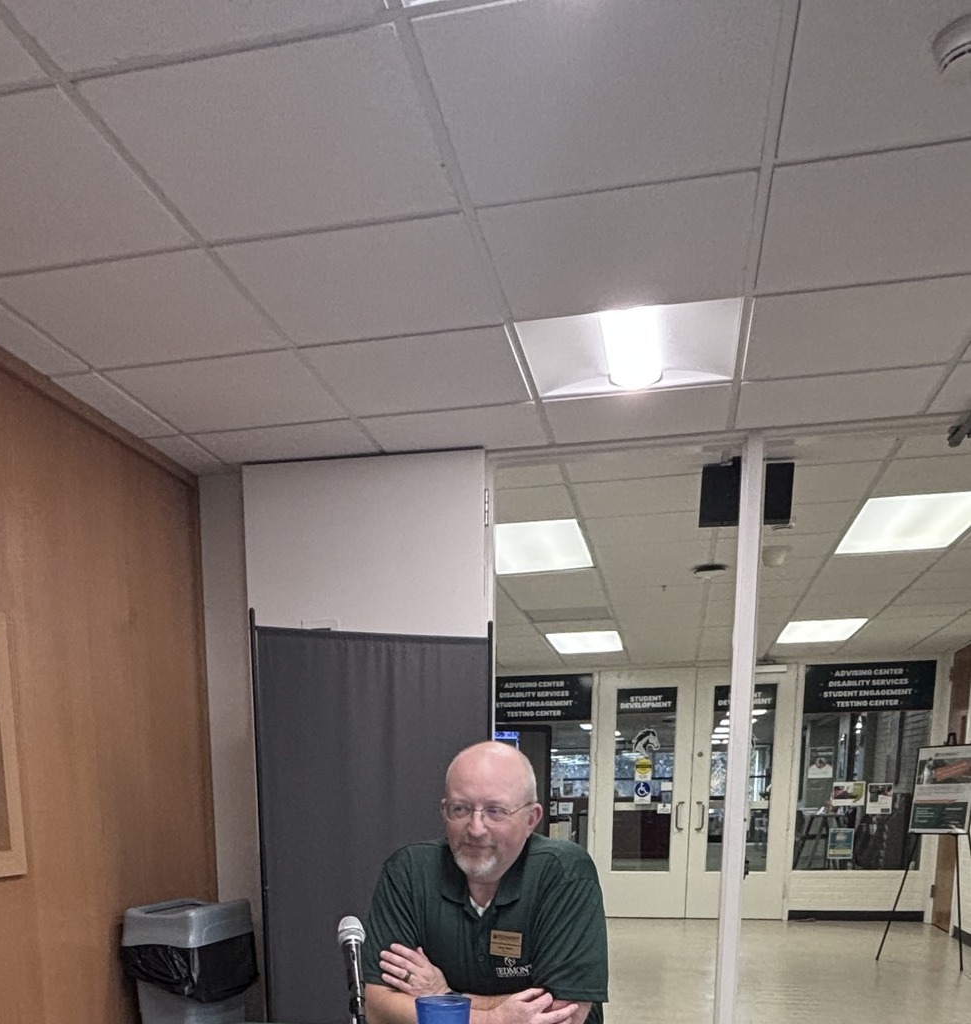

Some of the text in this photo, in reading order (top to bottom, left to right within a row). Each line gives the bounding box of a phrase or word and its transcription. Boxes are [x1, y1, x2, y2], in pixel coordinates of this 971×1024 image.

[504, 681, 537, 689] ADVISING
[537, 690, 569, 698] SERVICES
[823, 688, 913, 698] STUDENT ENGAGEMENT
[620, 701, 672, 709] DEVELOPMENT
